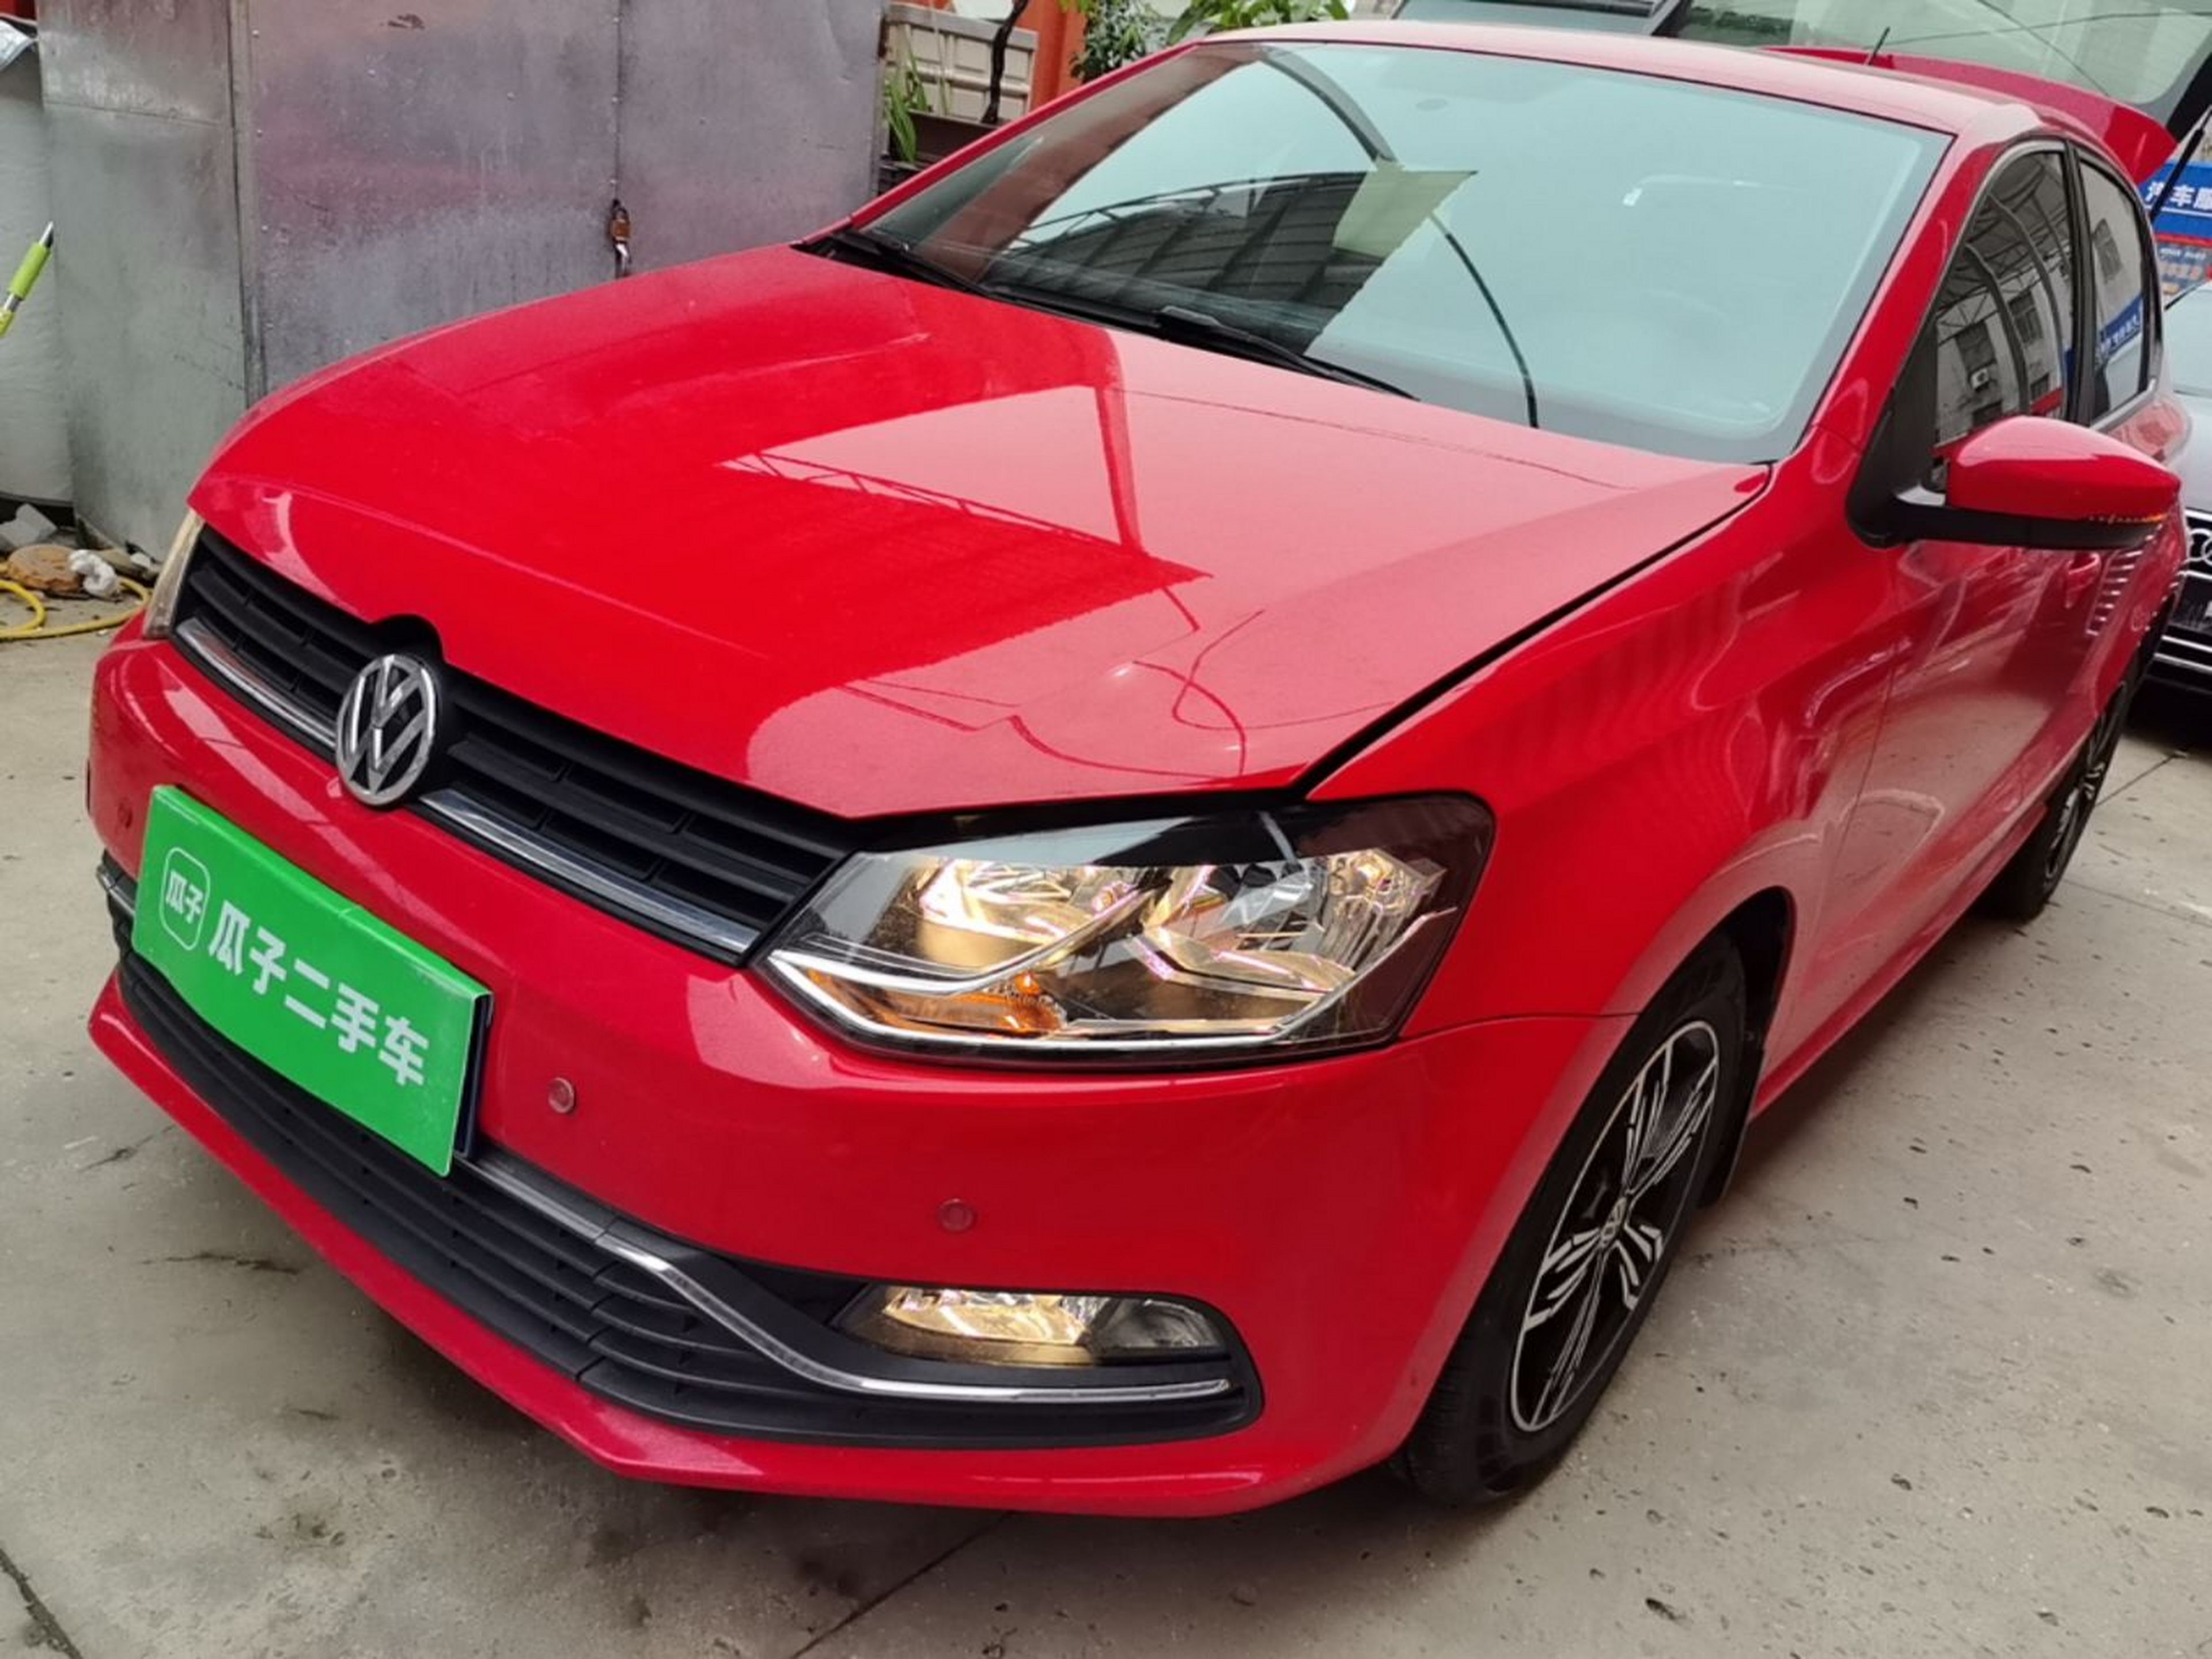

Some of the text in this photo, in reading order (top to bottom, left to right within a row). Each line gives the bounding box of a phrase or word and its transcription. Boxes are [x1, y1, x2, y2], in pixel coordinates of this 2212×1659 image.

[165, 870, 204, 922] 瓜子
[208, 900, 429, 1085] 瓜子二手车
